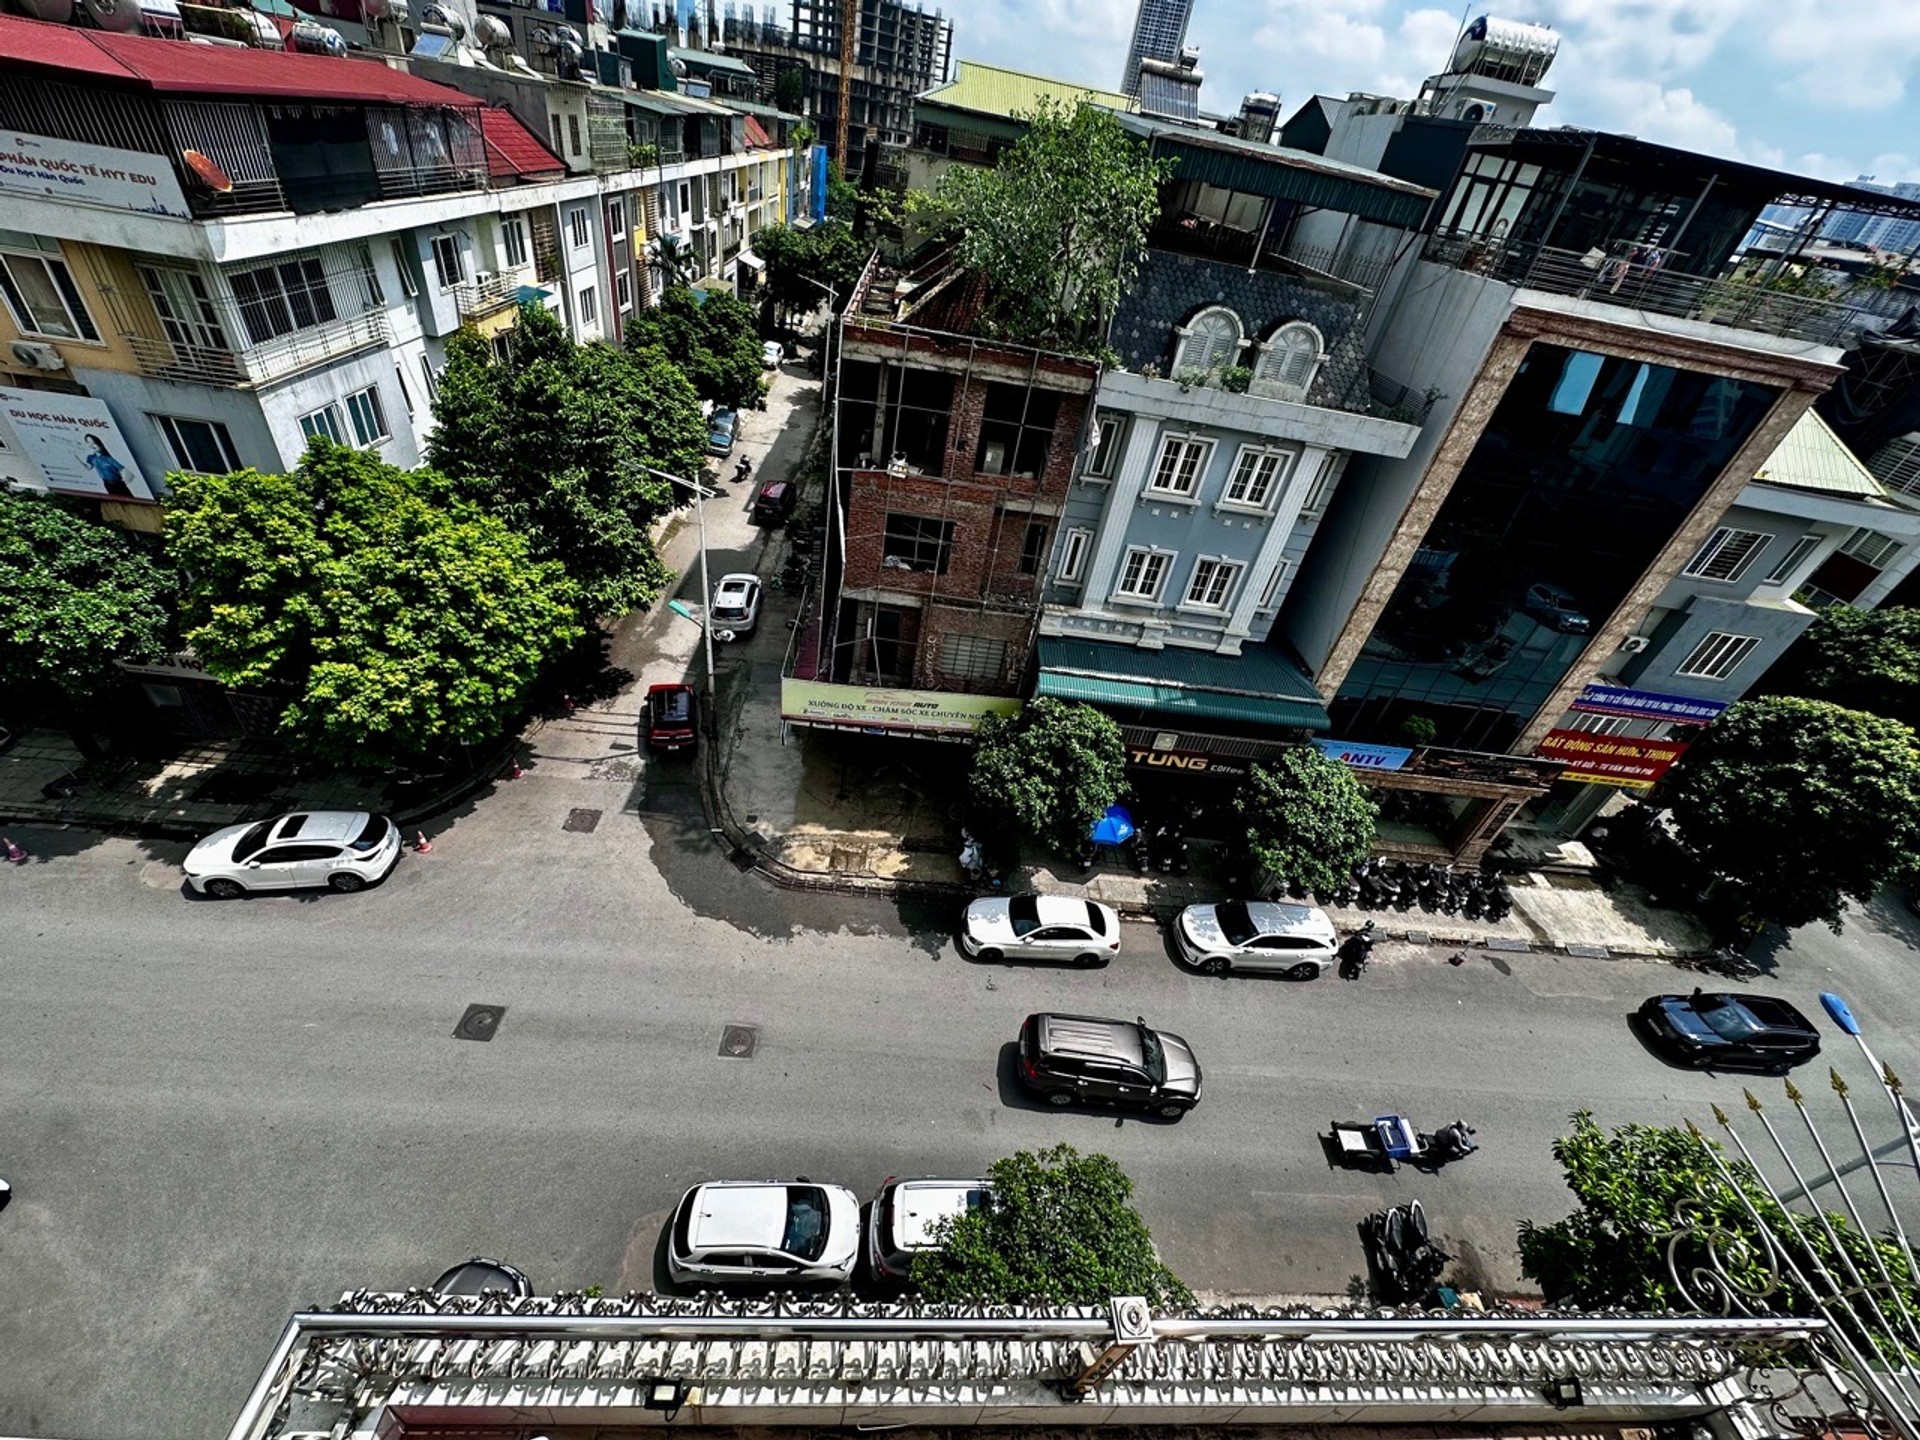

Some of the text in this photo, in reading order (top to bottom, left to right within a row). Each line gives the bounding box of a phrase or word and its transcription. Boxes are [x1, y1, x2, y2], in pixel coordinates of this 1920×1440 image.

[40, 159, 79, 173] QUỐC
[80, 163, 99, 177] TẾ
[100, 168, 126, 181] HYT
[130, 173, 157, 186] EDU
[9, 409, 26, 419] DU
[27, 411, 52, 422] HỌC
[52, 413, 77, 425] HÀN
[78, 417, 110, 429] QUỐC
[919, 709, 930, 717] XE
[1542, 735, 1567, 748] BẤT
[1563, 739, 1595, 752] ĐỘNG
[1593, 740, 1617, 754] SẢN
[1131, 750, 1209, 770] TUNG
[1340, 752, 1387, 766] ANTV
